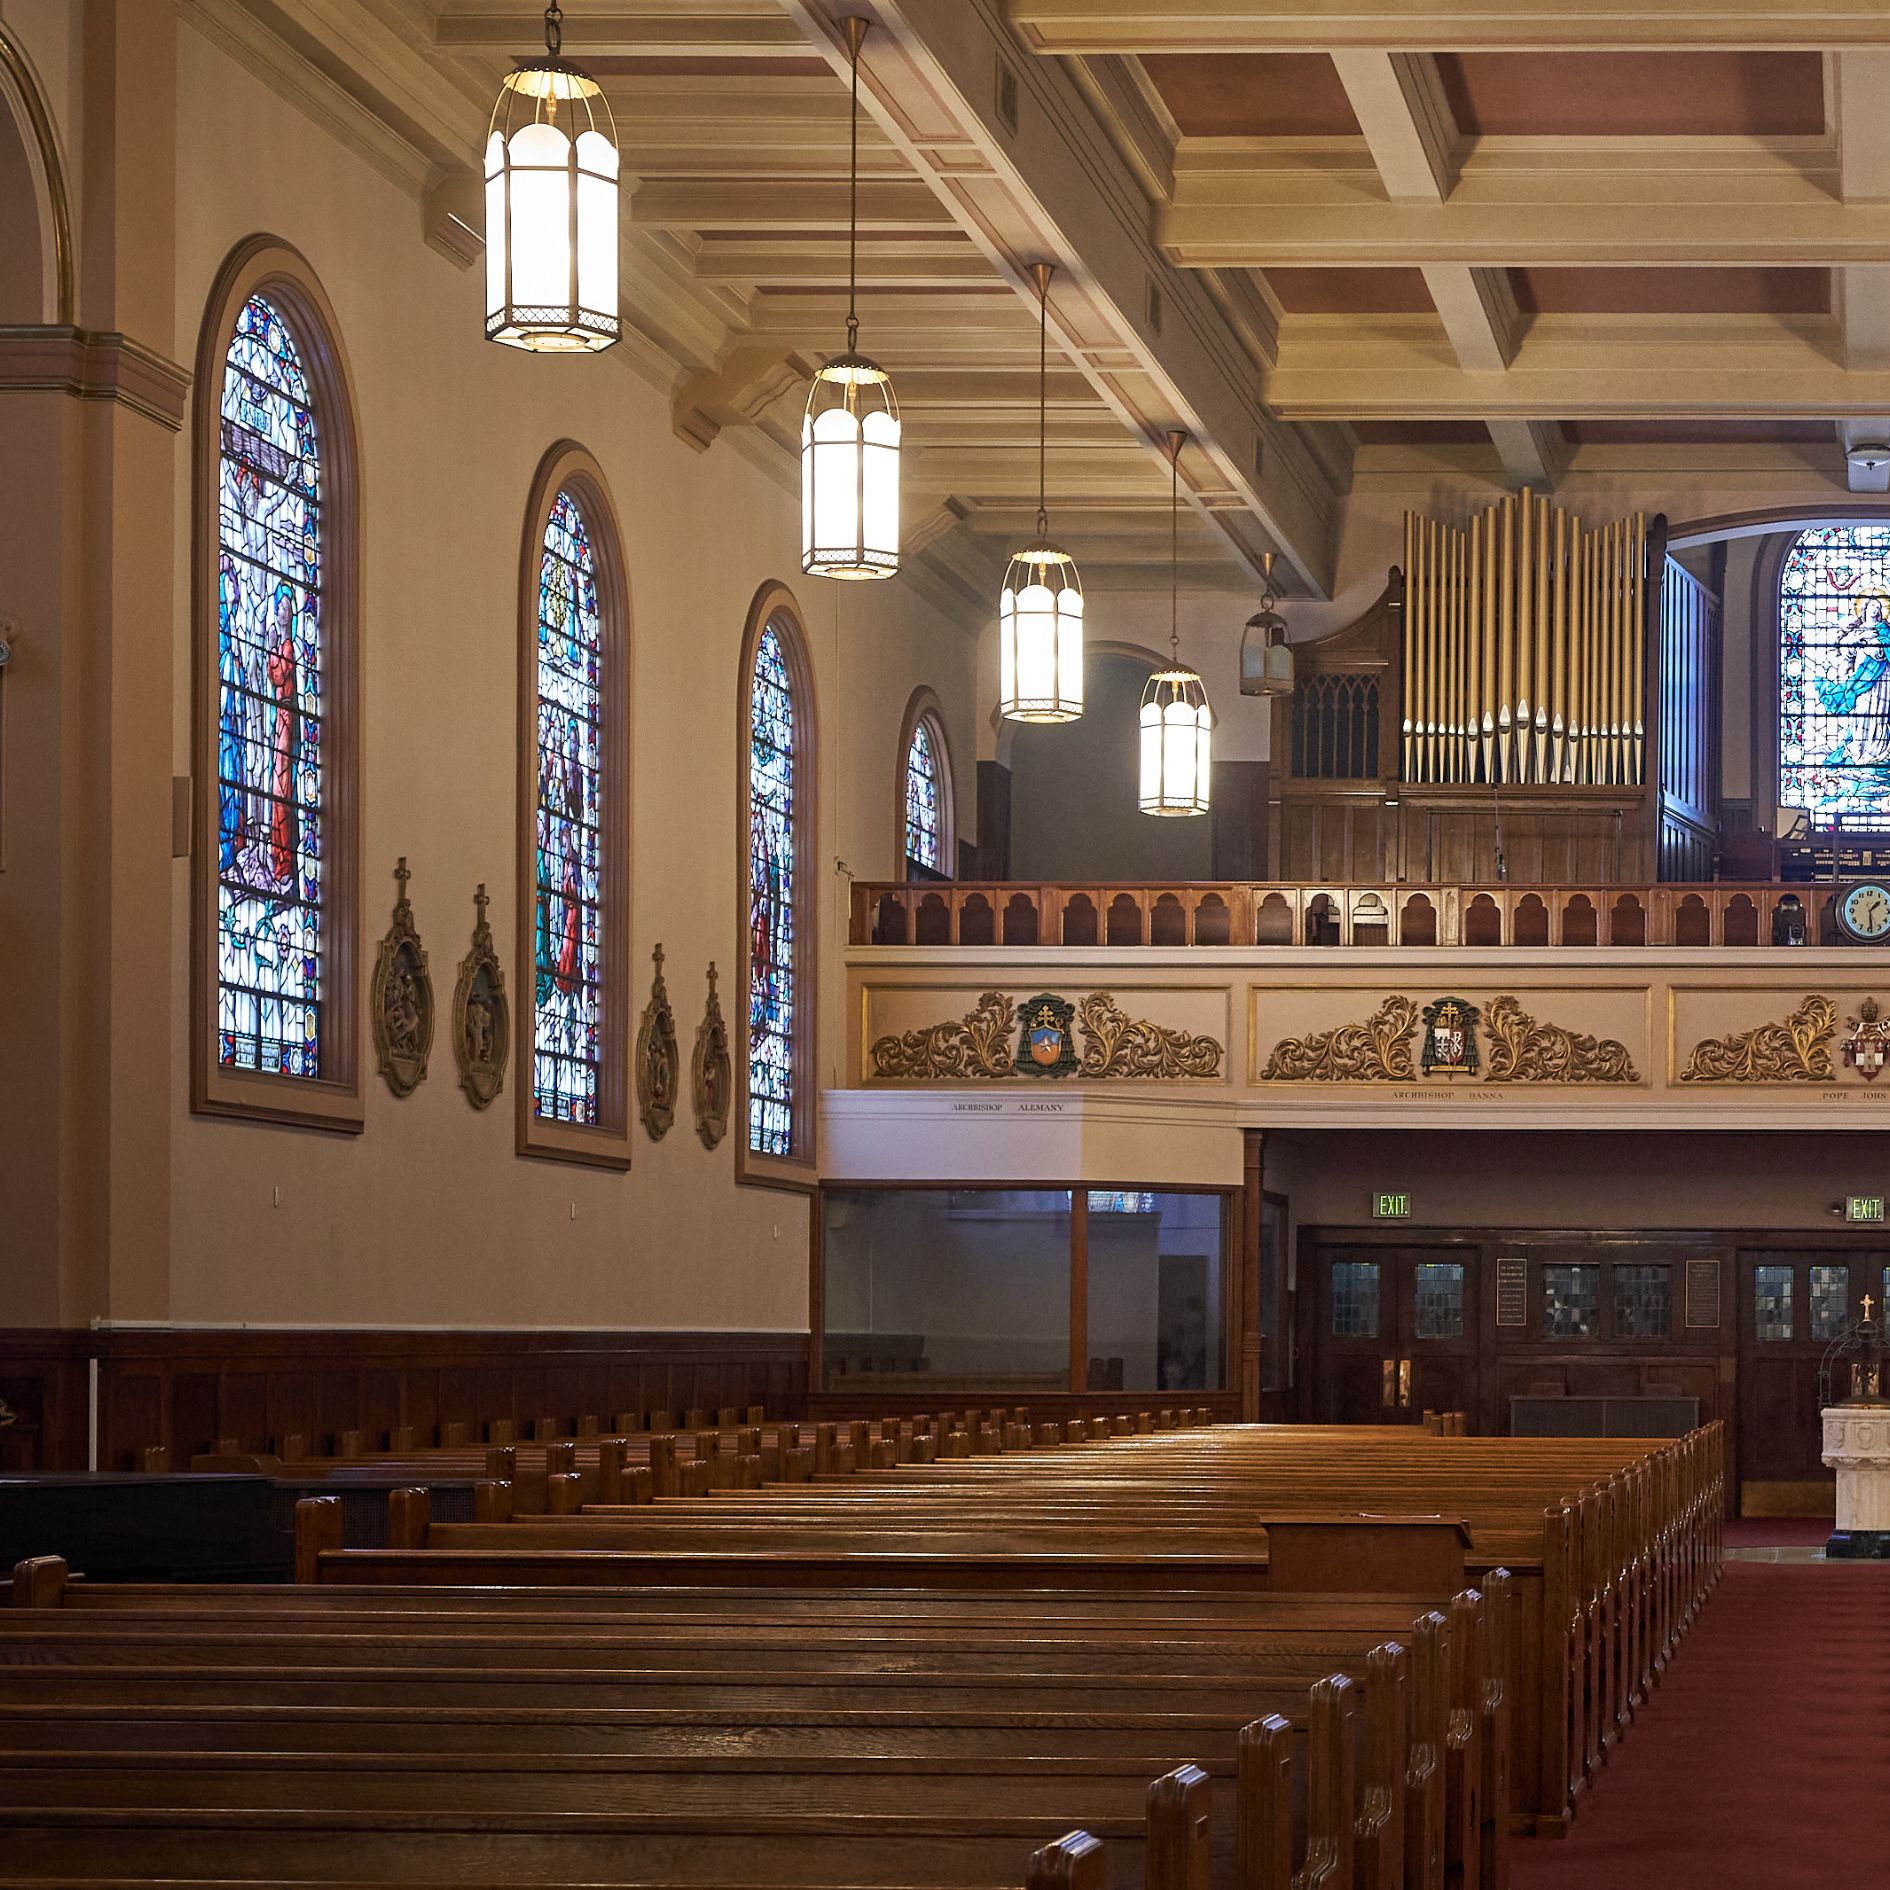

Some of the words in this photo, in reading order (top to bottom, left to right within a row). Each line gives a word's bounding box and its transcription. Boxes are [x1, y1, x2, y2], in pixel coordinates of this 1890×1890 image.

[1392, 1091, 1455, 1100] ARCHBISHOP
[1469, 1091, 1504, 1100] HANNA
[1822, 1092, 1849, 1100] POPE
[1863, 1092, 1887, 1100] JOHN
[951, 1103, 1003, 1111] ARCHBISHOP
[1018, 1103, 1064, 1112] ALEMANY
